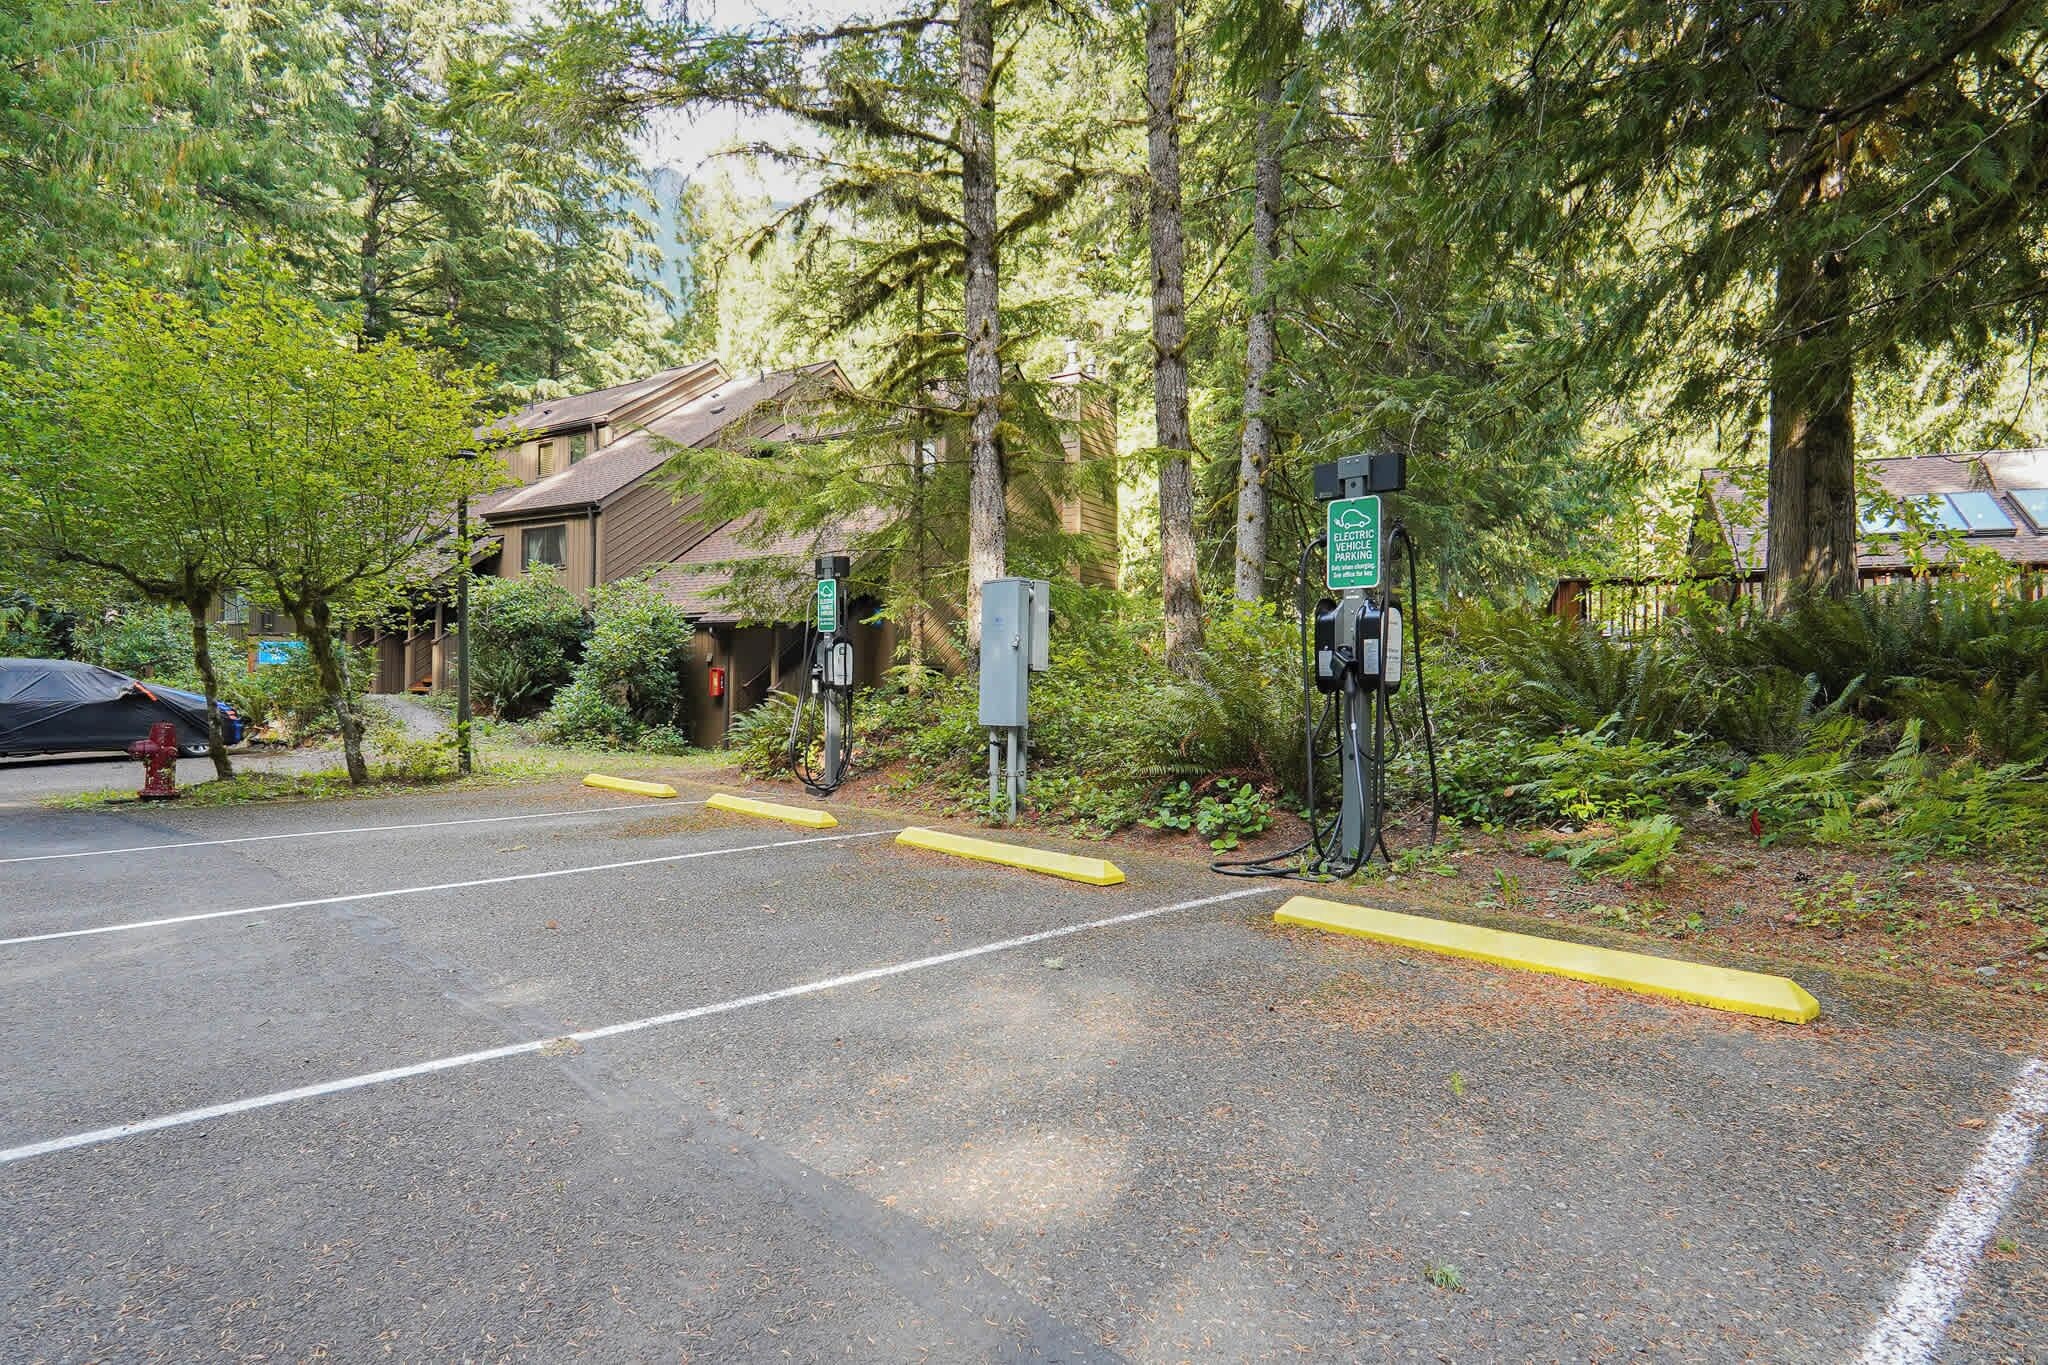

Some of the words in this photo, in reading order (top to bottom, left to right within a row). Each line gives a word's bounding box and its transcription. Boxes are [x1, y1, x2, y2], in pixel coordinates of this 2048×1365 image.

[1334, 530, 1375, 542] ELECTRIC
[1335, 540, 1372, 551] VEHICLE
[1335, 550, 1373, 562] PARKING
